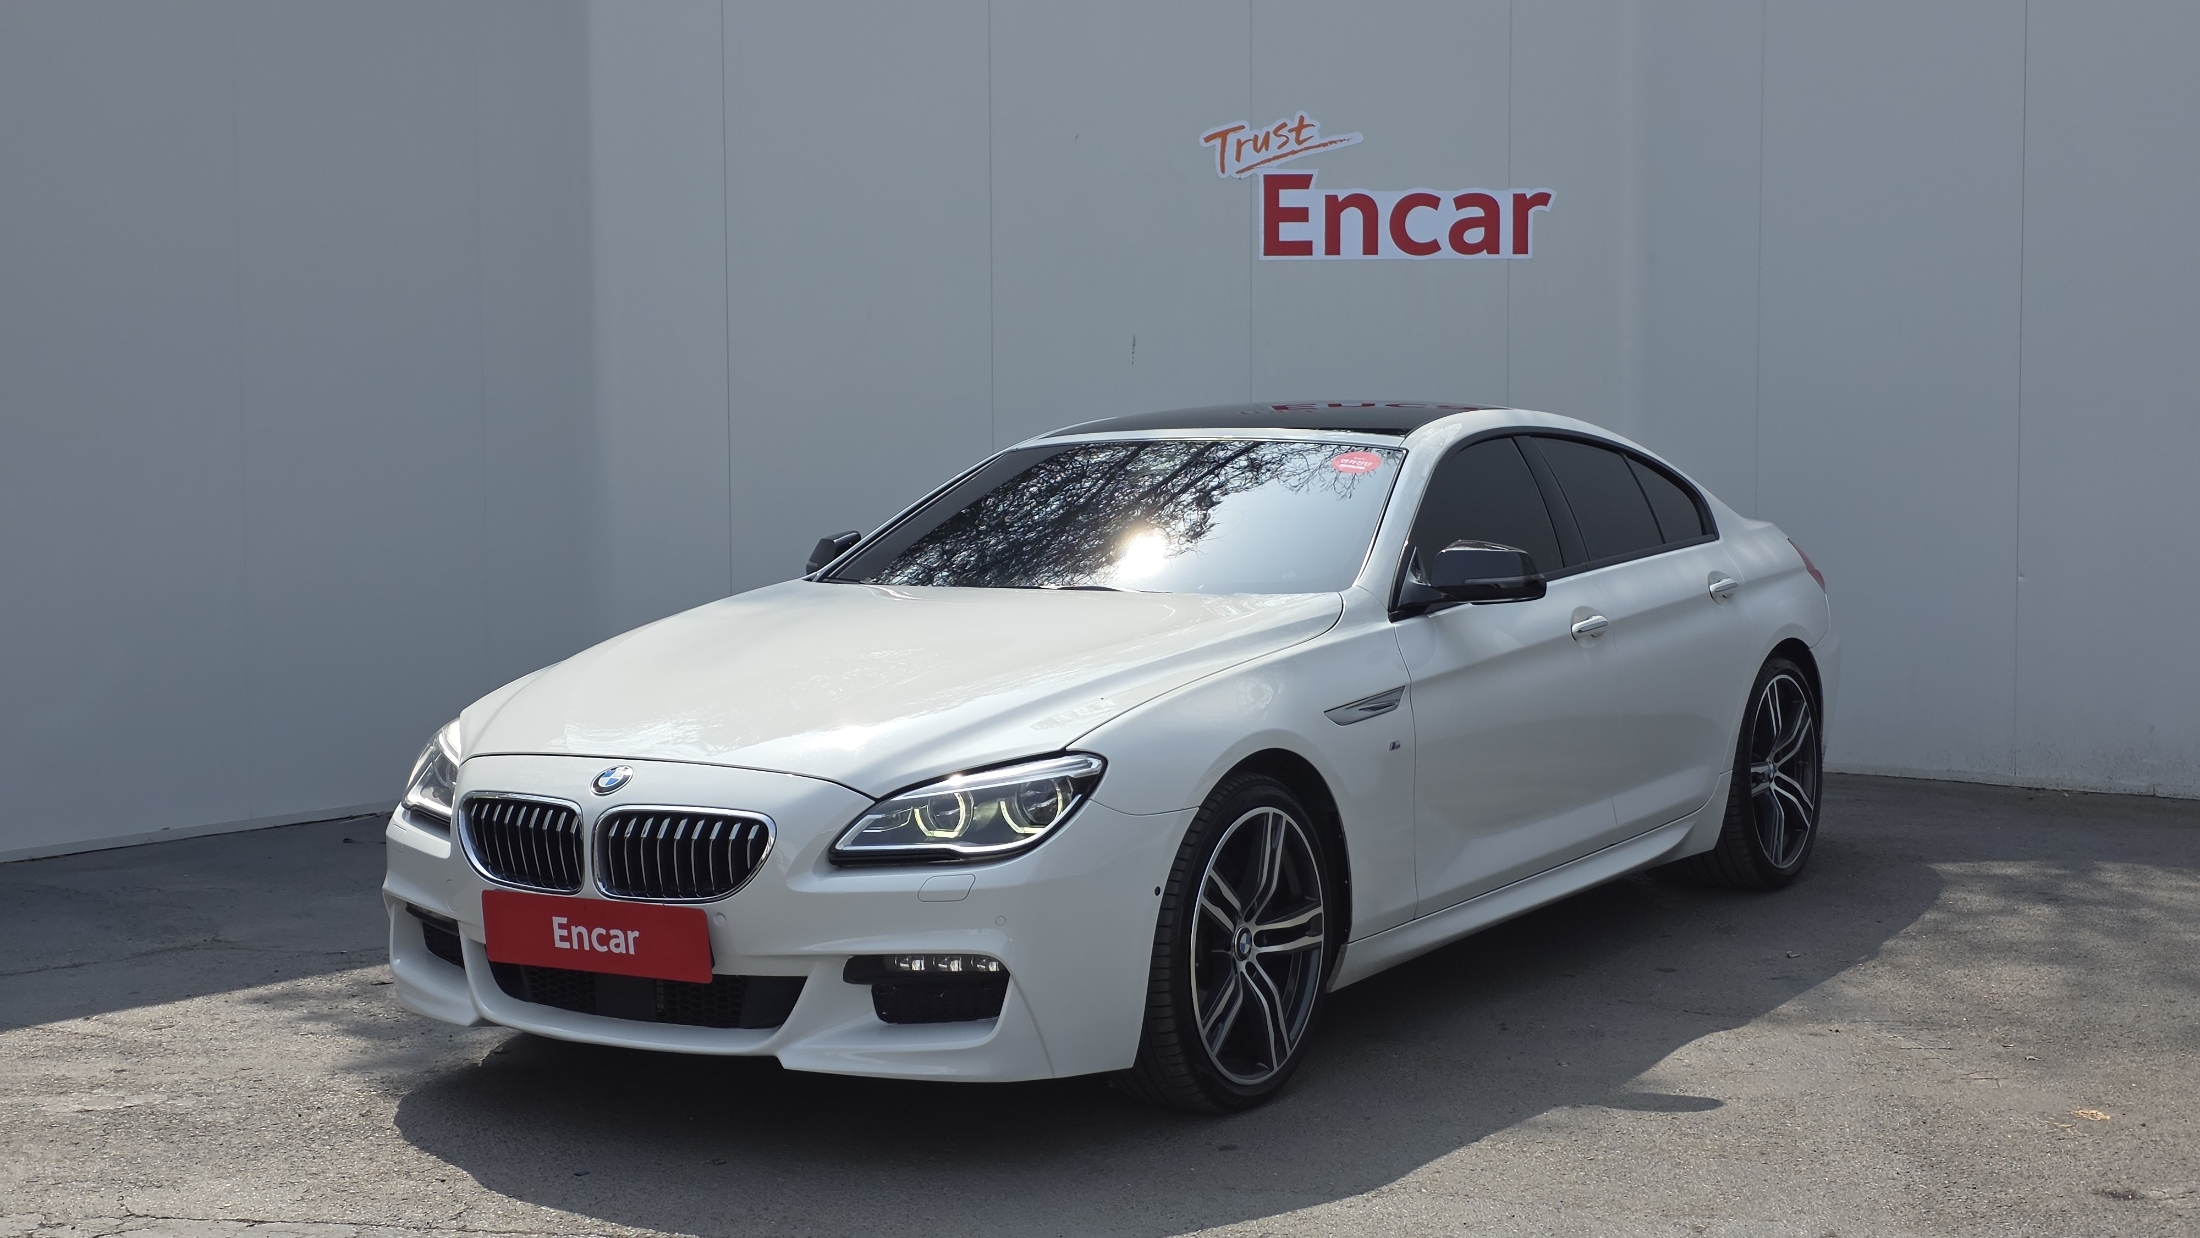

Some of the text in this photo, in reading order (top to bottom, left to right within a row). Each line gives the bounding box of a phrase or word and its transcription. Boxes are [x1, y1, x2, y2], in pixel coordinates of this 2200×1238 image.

[1203, 115, 1316, 174] Trust
[1263, 174, 1552, 256] Encar
[552, 916, 640, 955] Encar
